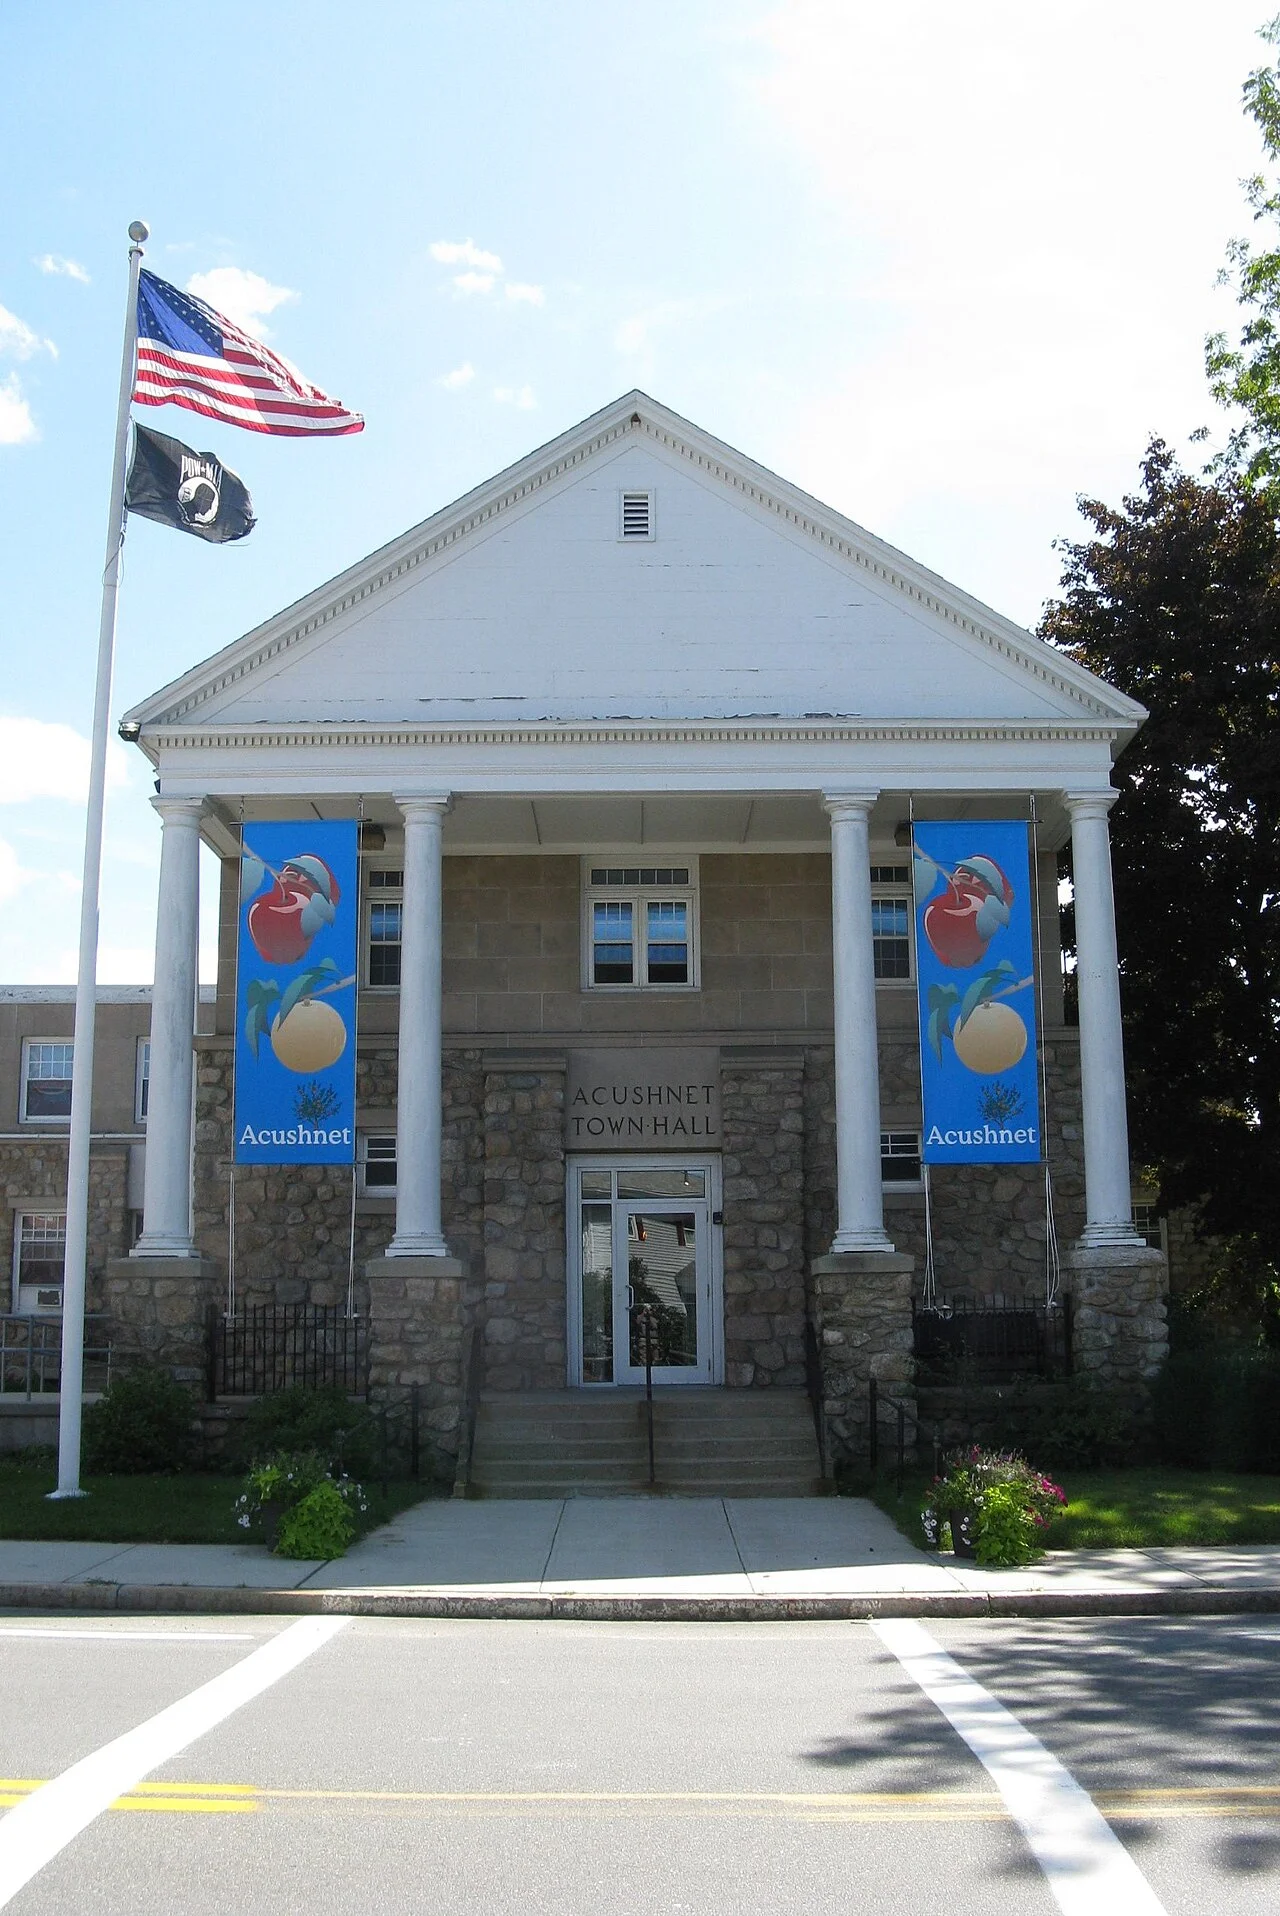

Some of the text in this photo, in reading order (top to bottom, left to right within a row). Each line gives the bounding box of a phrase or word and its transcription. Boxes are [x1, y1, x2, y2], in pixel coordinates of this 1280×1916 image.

[180, 455, 200, 484] POW
[572, 1085, 715, 1106] ACUSHNET
[239, 1124, 351, 1145] Acushnet
[653, 1115, 717, 1136] HALL
[926, 1124, 1037, 1145] Acushnet
